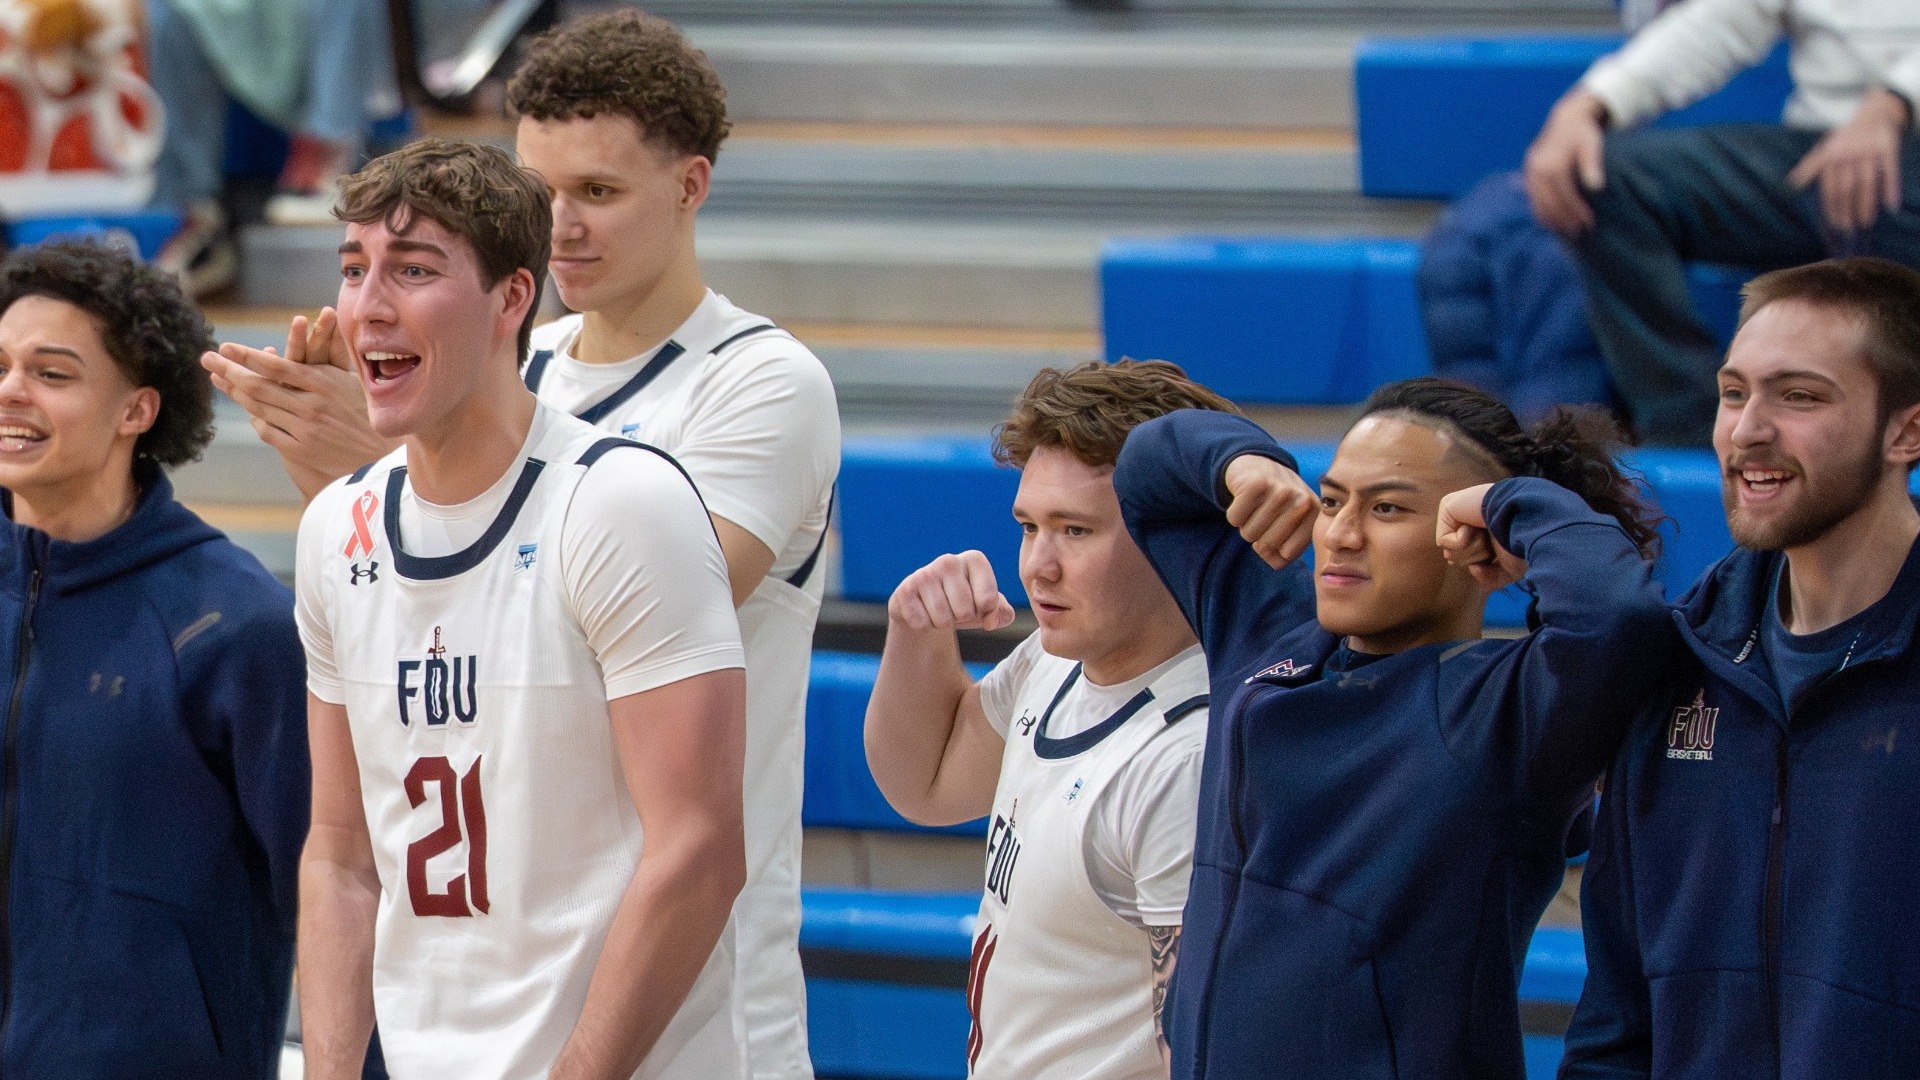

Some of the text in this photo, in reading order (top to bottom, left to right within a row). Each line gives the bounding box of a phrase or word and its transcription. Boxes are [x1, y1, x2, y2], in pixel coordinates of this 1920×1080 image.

[398, 655, 477, 726] FDU
[1667, 749, 1714, 760] BASKETBALL
[1669, 707, 1719, 749] FDU
[404, 754, 490, 917] 21
[986, 814, 1020, 906] FDU
